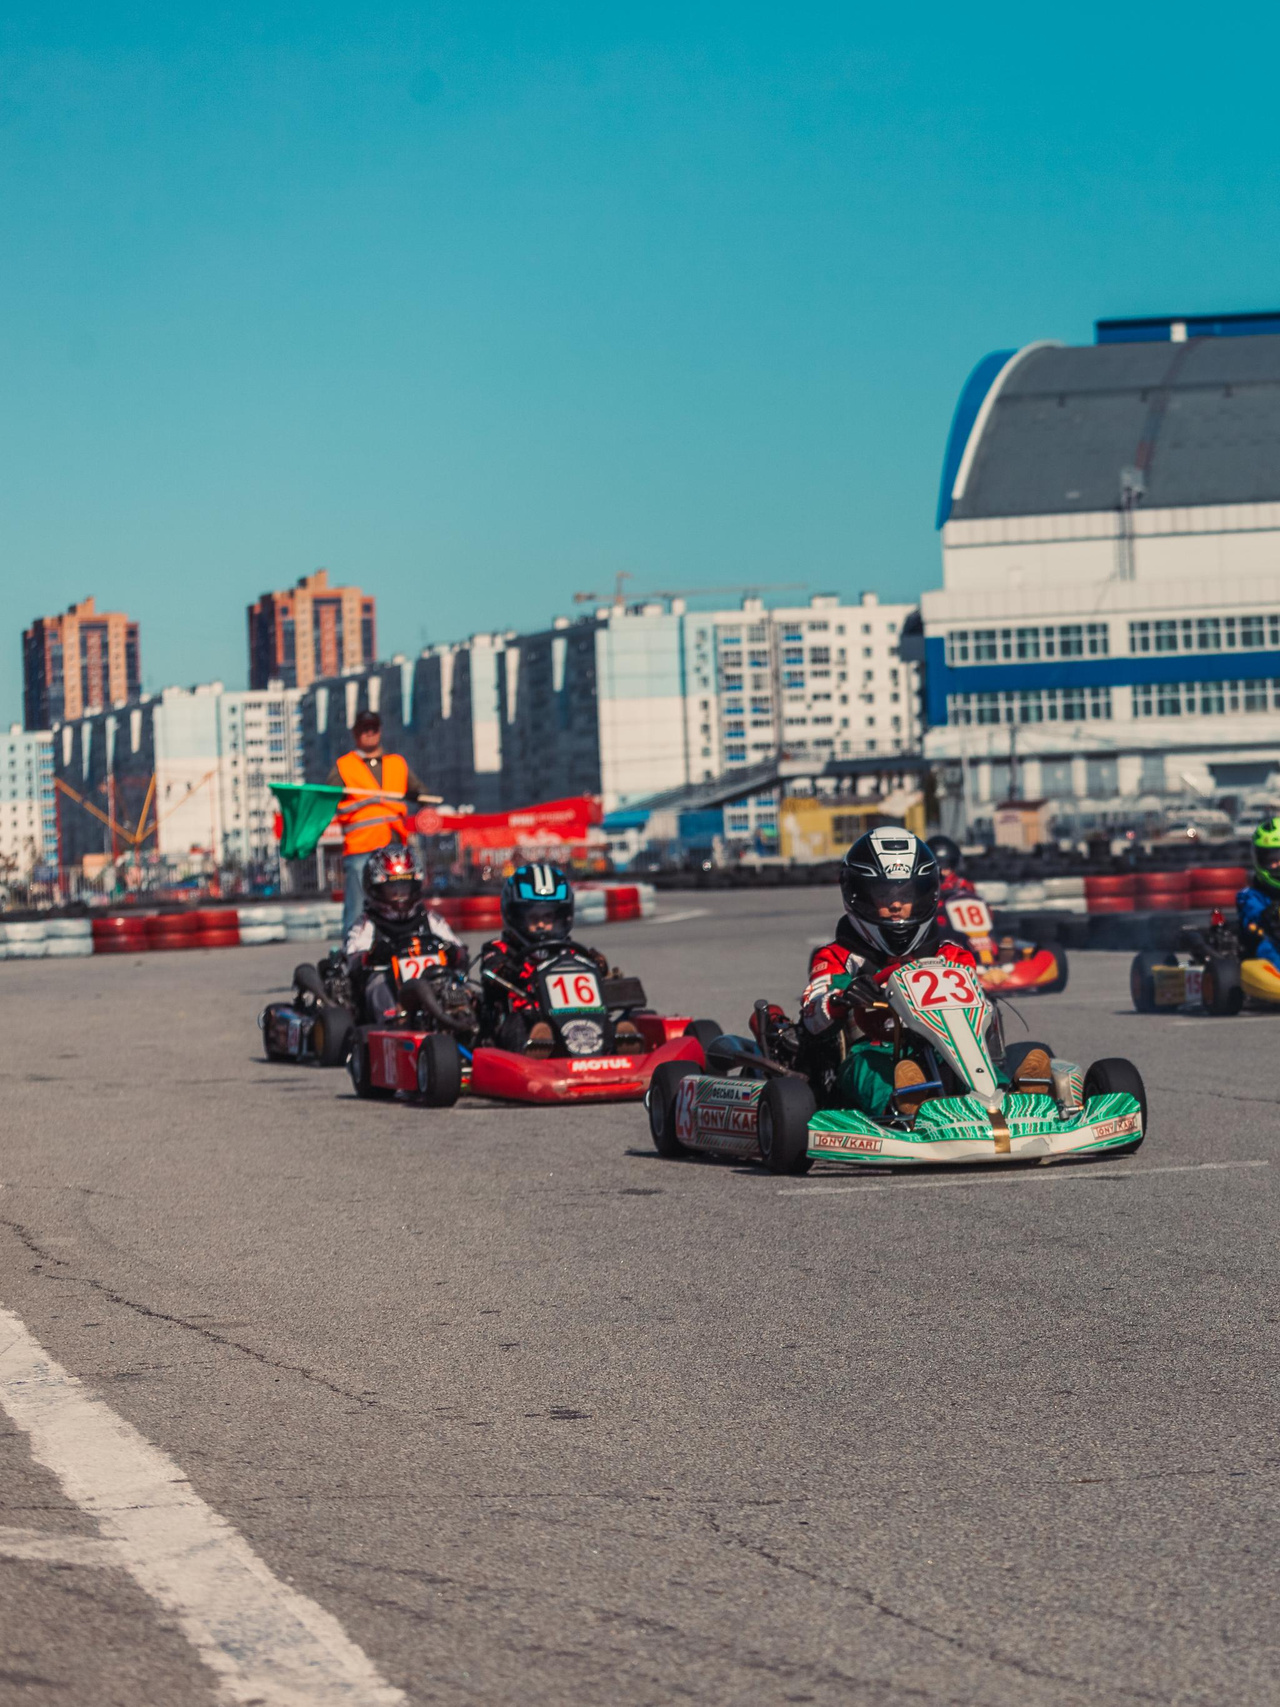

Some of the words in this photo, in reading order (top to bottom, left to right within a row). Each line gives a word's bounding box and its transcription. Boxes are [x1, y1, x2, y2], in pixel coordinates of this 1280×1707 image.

[953, 905, 984, 928] 18
[552, 975, 595, 1006] 16
[911, 969, 975, 1007] 23
[572, 1058, 631, 1072] MOTUL
[699, 1104, 726, 1130] TONY
[731, 1107, 758, 1132] KAR
[1092, 1122, 1114, 1139] TONY
[815, 1134, 843, 1147] TONY
[849, 1137, 881, 1152] KART
